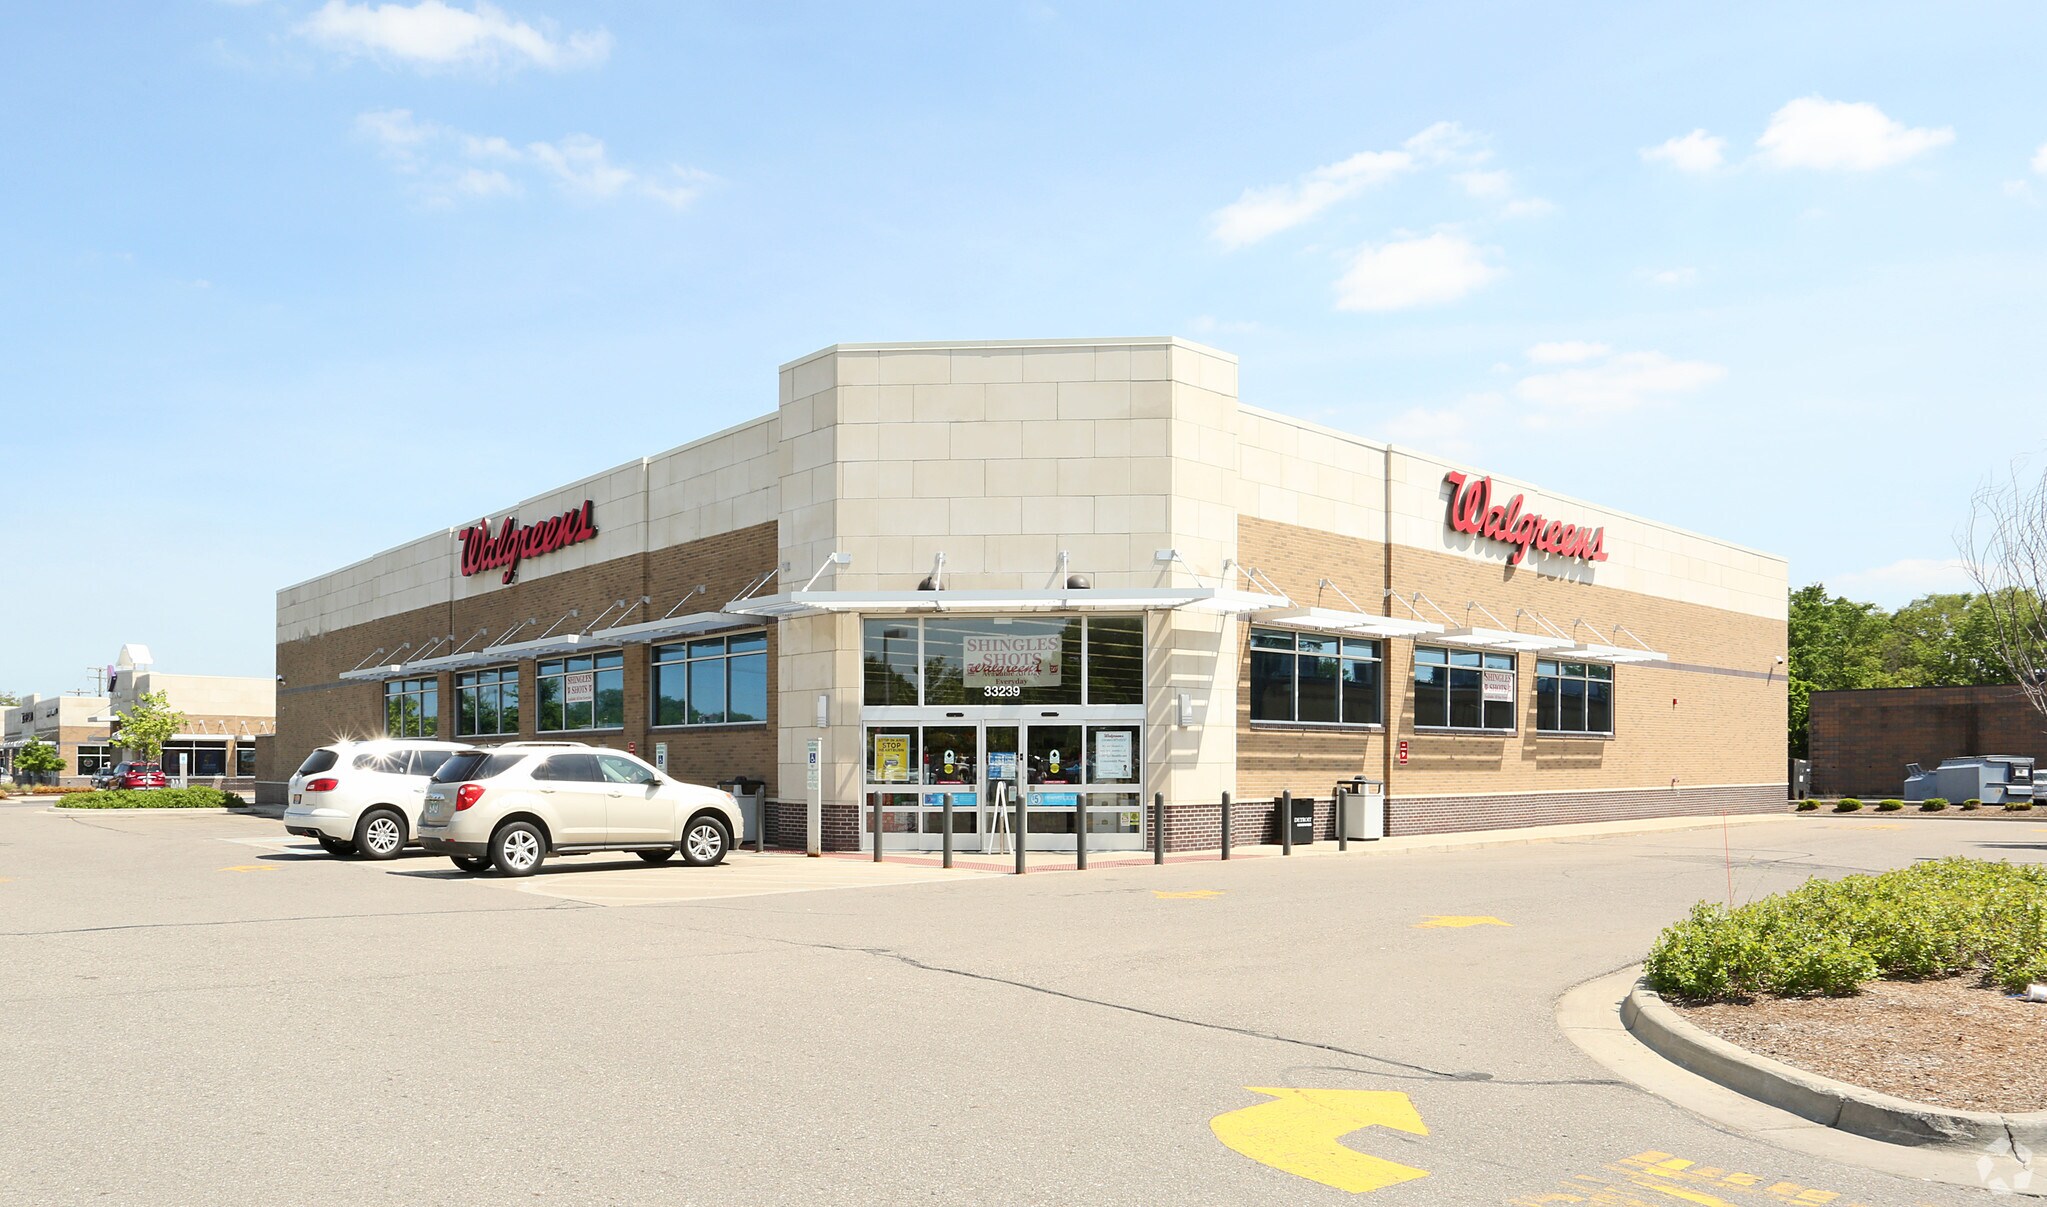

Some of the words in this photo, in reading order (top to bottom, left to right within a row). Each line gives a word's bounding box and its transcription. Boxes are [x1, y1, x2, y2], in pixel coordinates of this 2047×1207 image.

[1445, 471, 1609, 565] Walgreens
[458, 500, 599, 584] Walgreens
[967, 637, 1059, 652] SHINGLES
[983, 653, 1042, 667] SHOTS
[969, 659, 1042, 676] Walgreens
[567, 675, 592, 684] SHINGLES
[995, 678, 1028, 686] Everyday
[1484, 672, 1511, 683] SHINGLES
[983, 685, 1021, 697] 33239
